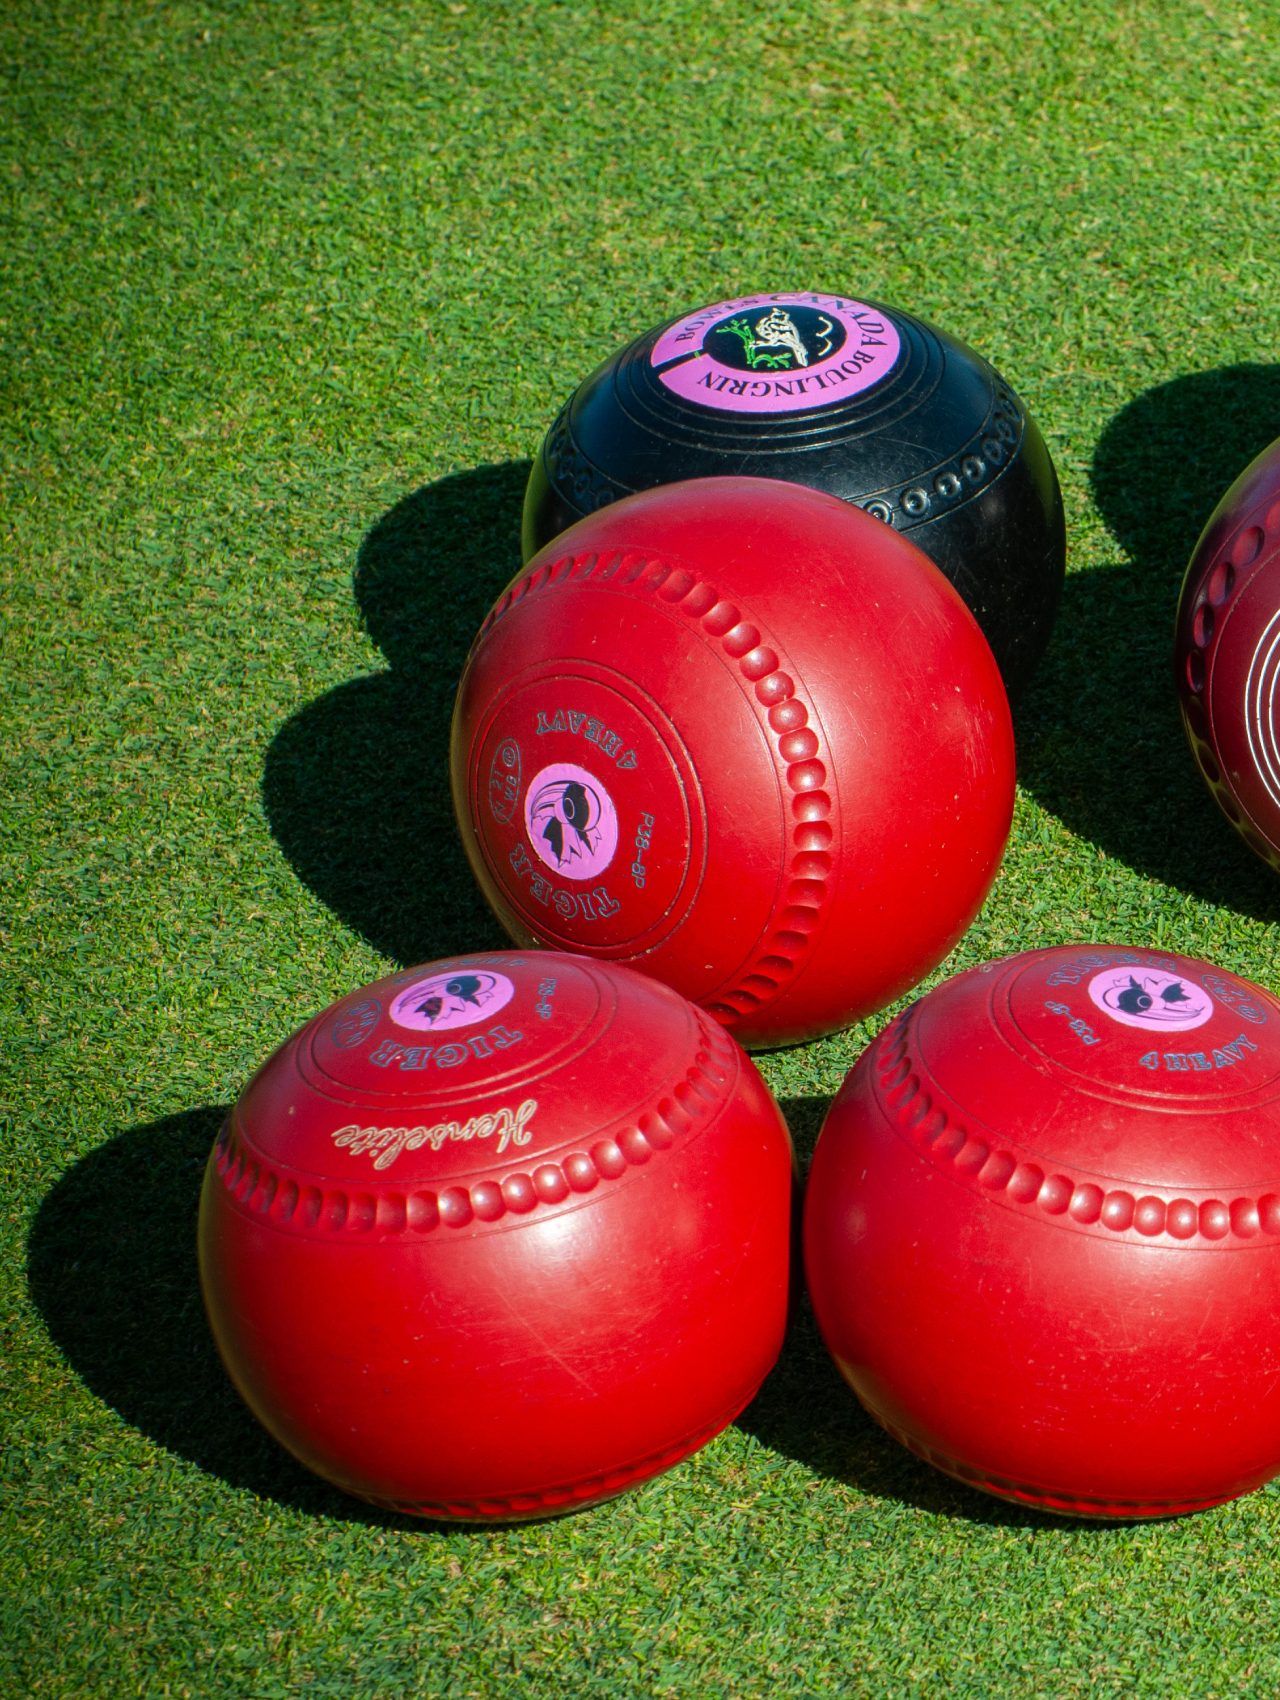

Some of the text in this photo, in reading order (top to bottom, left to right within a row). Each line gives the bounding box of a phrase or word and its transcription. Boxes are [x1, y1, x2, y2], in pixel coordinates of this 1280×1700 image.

[769, 293, 888, 347] CANADA
[697, 350, 875, 398] BOULINGRIN
[536, 710, 623, 762] HEAVY
[508, 843, 623, 921] TIGER
[369, 1025, 524, 1071] TIGER
[1163, 1033, 1258, 1072] HEAVY
[330, 1099, 538, 1171] Henselite
